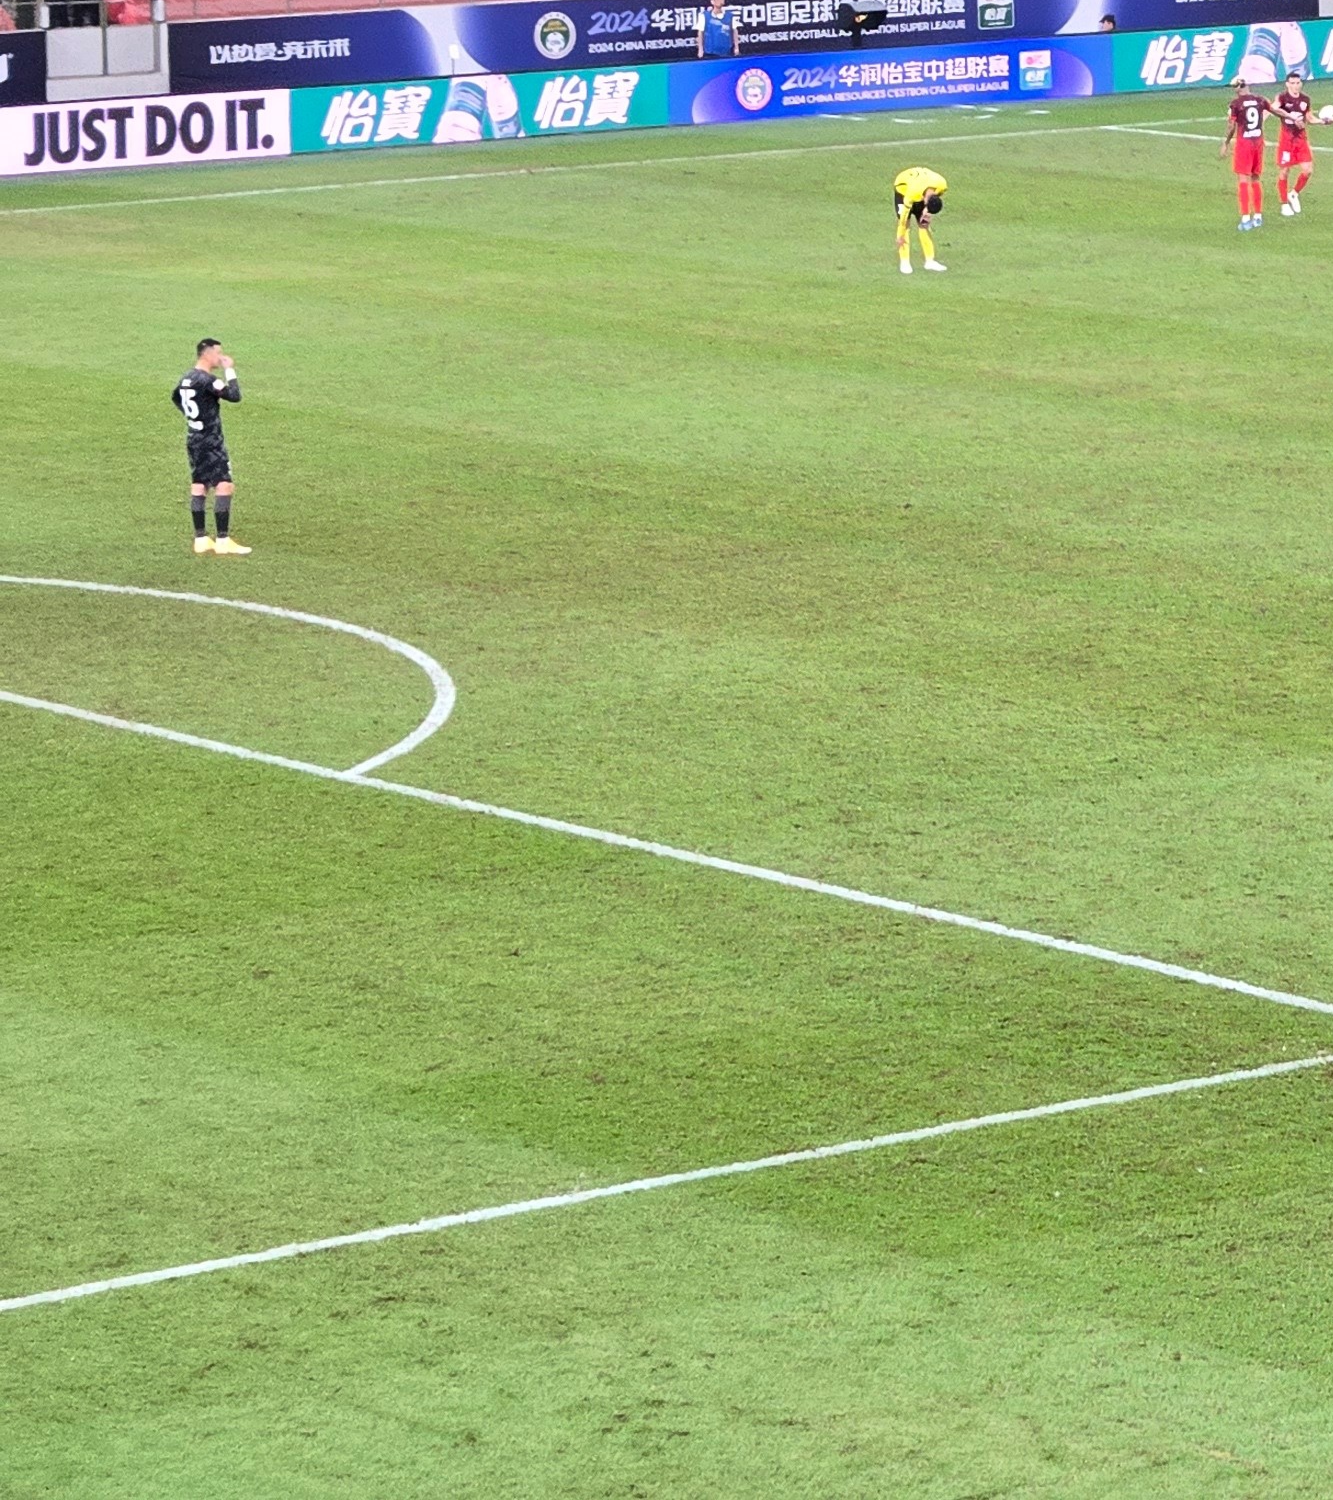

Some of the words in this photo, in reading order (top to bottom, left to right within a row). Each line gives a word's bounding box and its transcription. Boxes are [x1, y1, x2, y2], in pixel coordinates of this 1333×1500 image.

[615, 40, 646, 52] CHINA
[749, 30, 789, 43] CHINESE
[790, 28, 838, 41] FOOTBALL
[900, 21, 930, 33] SUPER
[930, 19, 966, 31] LEAGUE
[975, 80, 1010, 92] LEAGUE
[24, 106, 135, 167] JUST
[145, 101, 215, 157] DO
[225, 97, 275, 152] IT.
[1245, 106, 1259, 130] 9
